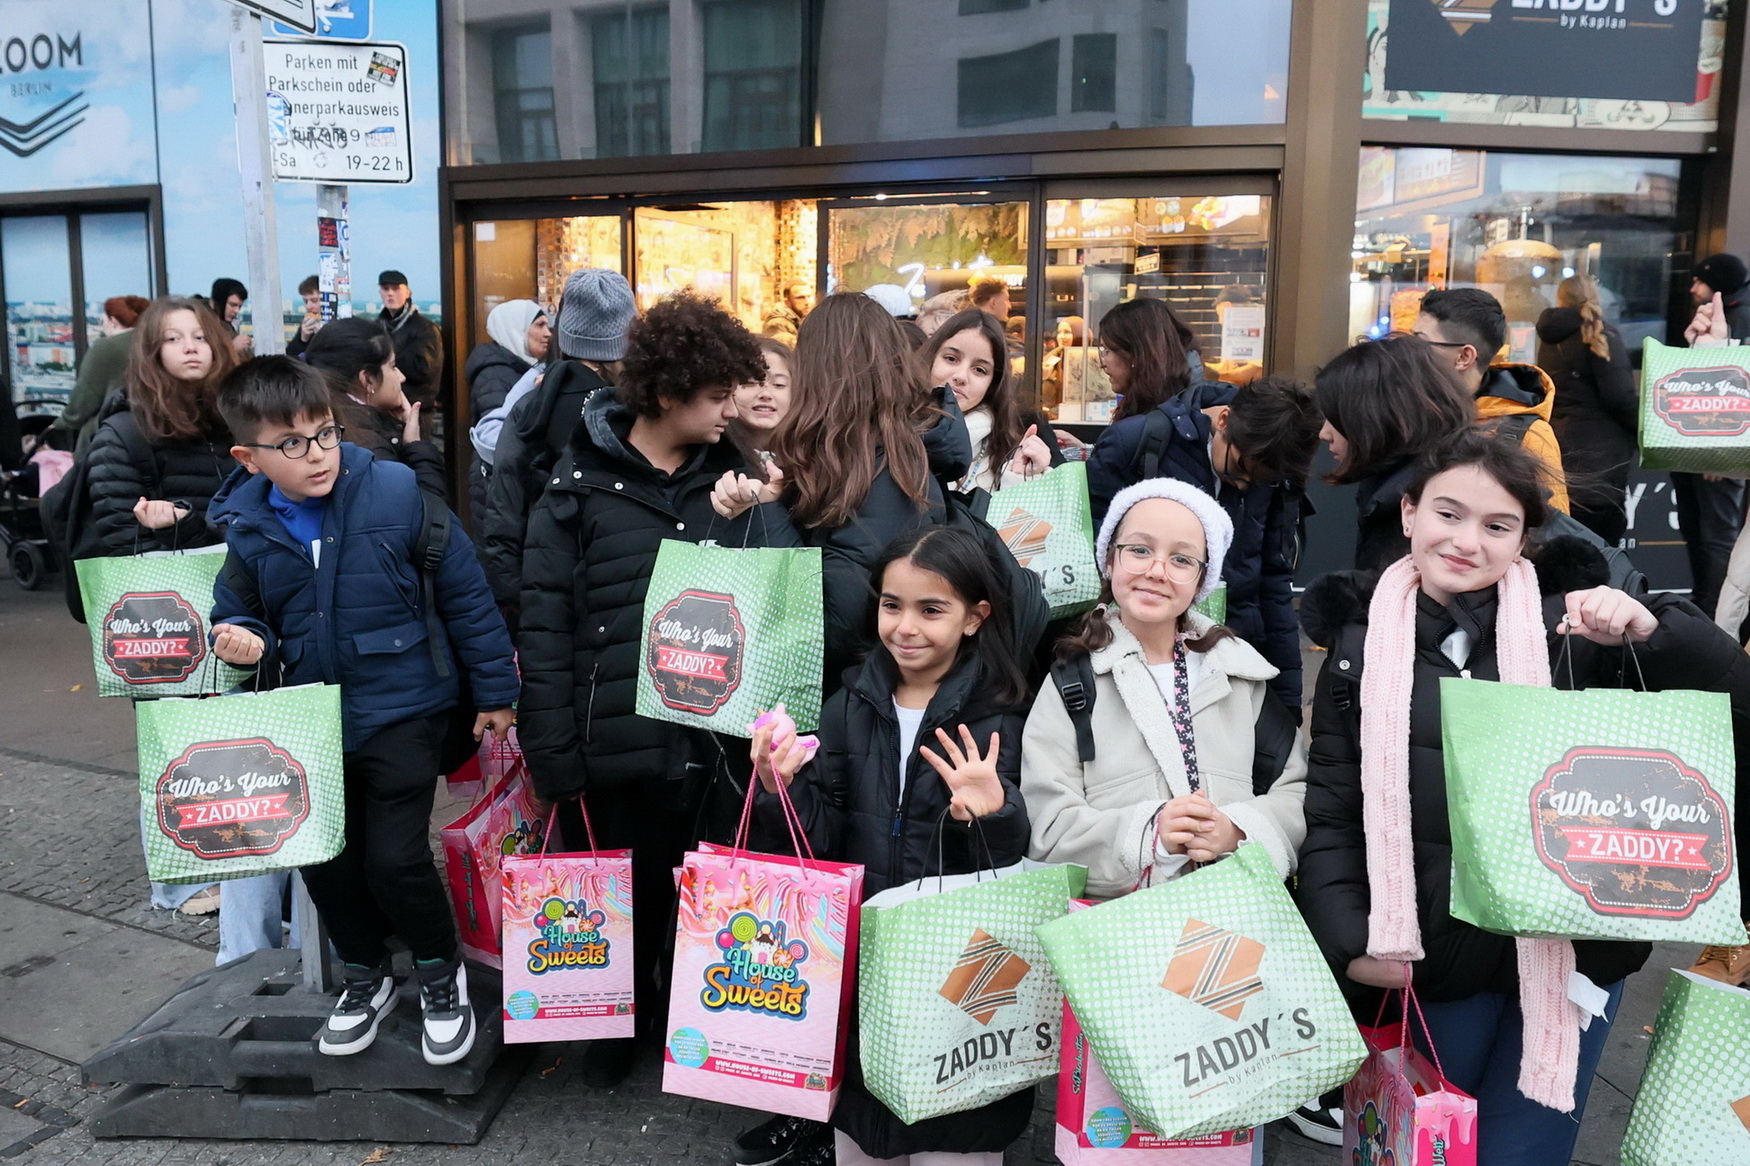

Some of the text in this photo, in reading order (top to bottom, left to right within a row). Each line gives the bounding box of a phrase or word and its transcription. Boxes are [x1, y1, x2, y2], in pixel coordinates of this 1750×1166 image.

[1560, 13, 1627, 30] by Kaplan
[0, 30, 83, 74] OOM
[285, 53, 332, 70] Parken
[337, 54, 358, 70] mit
[10, 81, 53, 98] BERLIN
[269, 75, 377, 93] Parkschein oder
[293, 100, 400, 119] nerparkausweis
[350, 128, 361, 142] 9
[346, 154, 391, 171] 19-22
[395, 157, 404, 171] h
[1663, 381, 1714, 393] Who's
[1681, 398, 1741, 410] ZADDY?
[110, 617, 192, 638] Who's Your
[658, 619, 734, 652] Who's Your
[124, 641, 177, 655] ZADDY?
[667, 651, 715, 675] ZADDY?
[168, 771, 292, 799] Who's Your
[196, 799, 271, 824] ZADDY?
[1549, 790, 1711, 830] Who's Your
[1588, 833, 1684, 861] ZADDY?
[543, 924, 598, 947] House
[563, 939, 575, 951] of
[529, 940, 608, 972] Sweets
[726, 947, 796, 983] House
[703, 966, 807, 1015] Sweets
[750, 972, 764, 989] of
[978, 1060, 1015, 1073] Kaplan
[1228, 1053, 1278, 1084] by Kaplan
